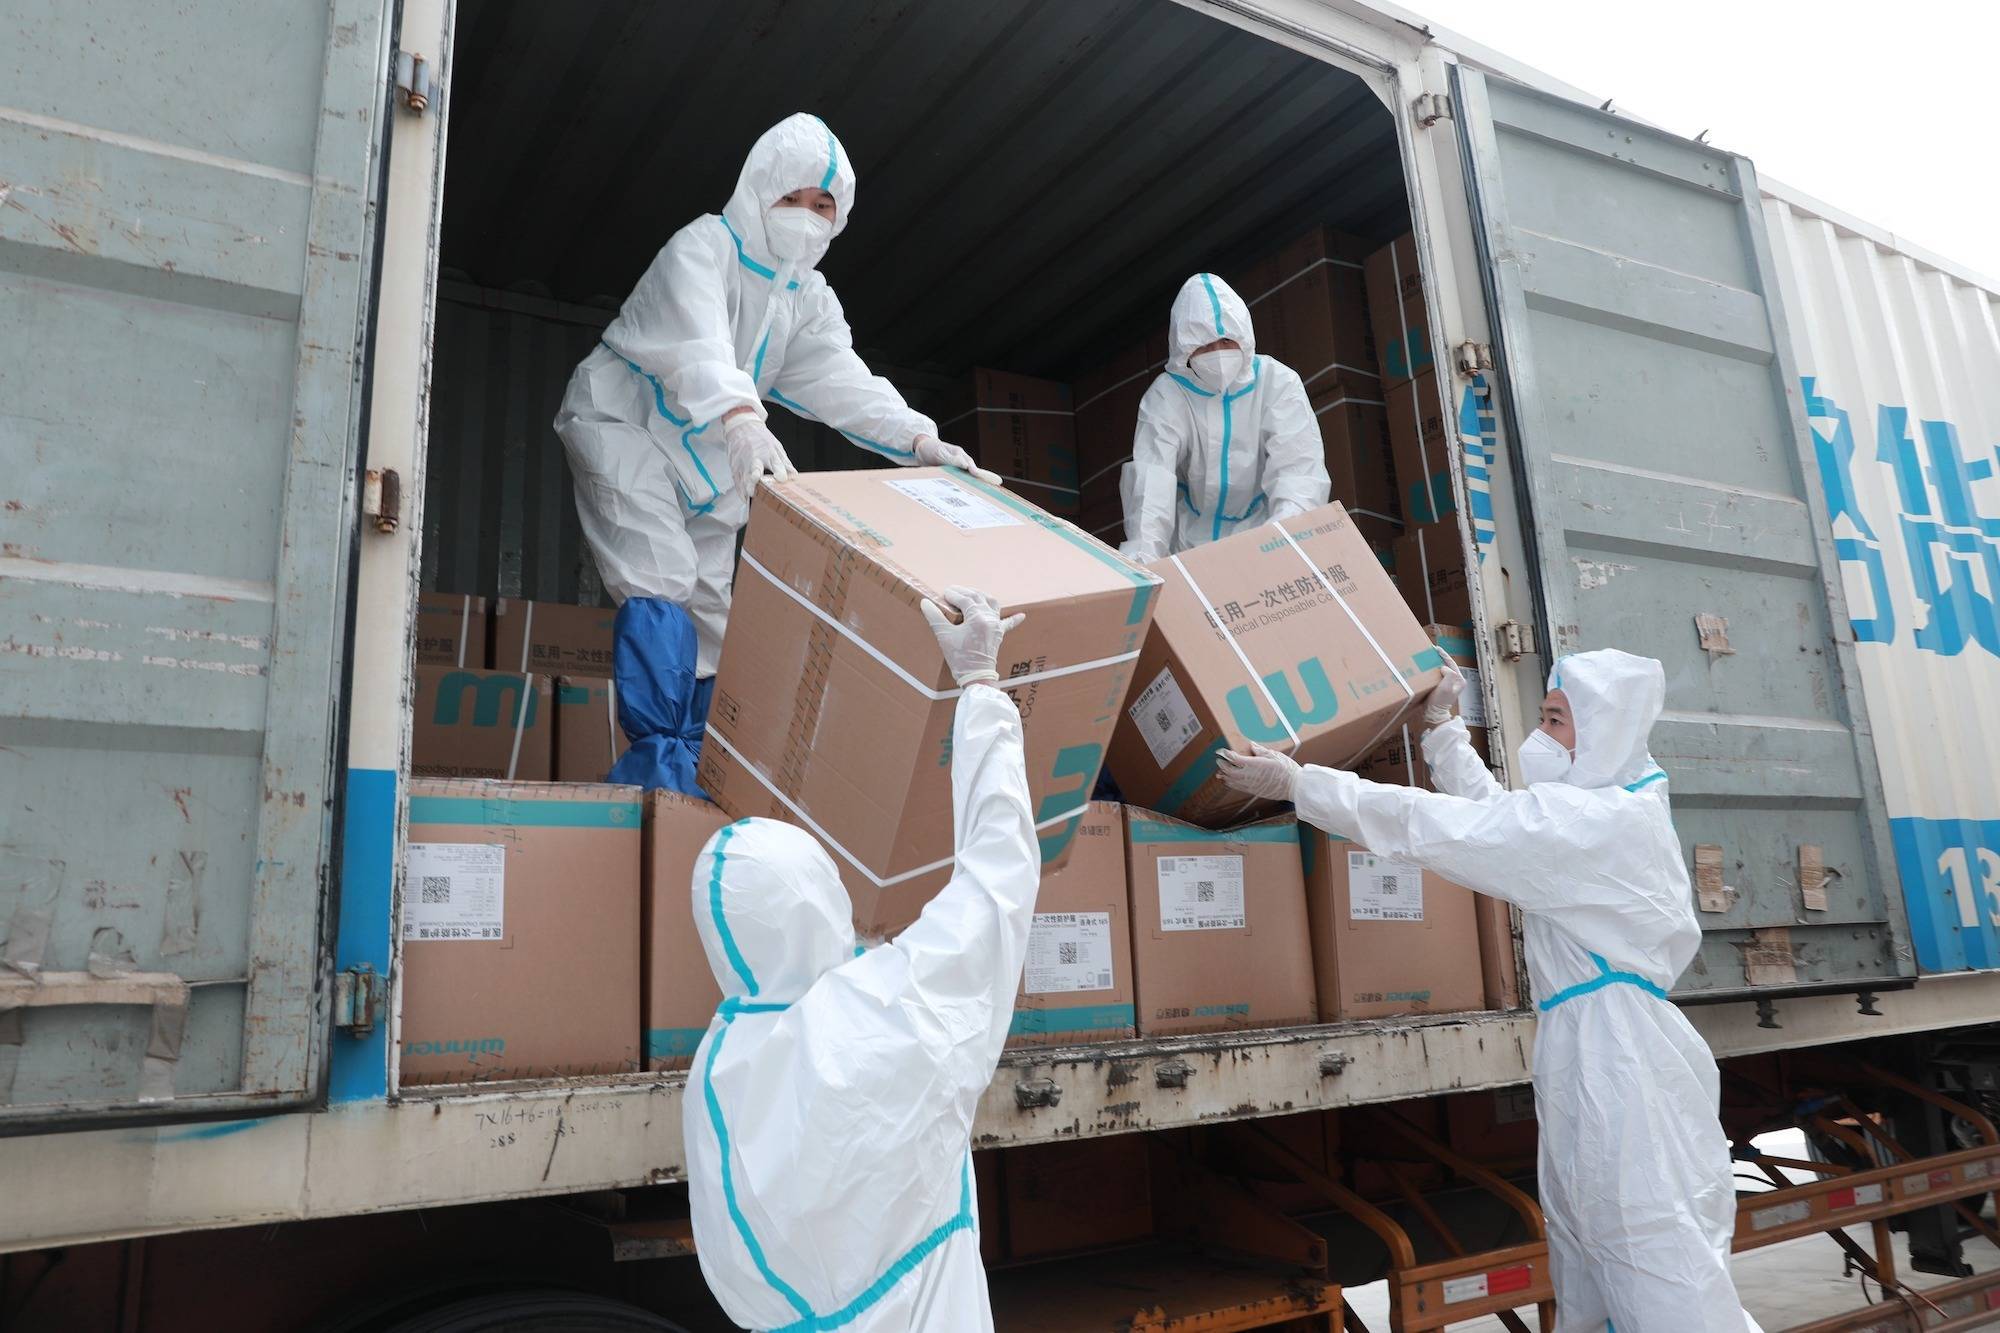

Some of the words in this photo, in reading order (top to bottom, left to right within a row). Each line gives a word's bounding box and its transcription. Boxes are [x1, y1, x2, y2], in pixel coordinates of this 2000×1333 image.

[1204, 564, 1350, 629] 医用一次性防护服
[1259, 598, 1317, 627] Disposable
[1317, 582, 1358, 605] Coerall
[1020, 656, 1047, 719] Coveall
